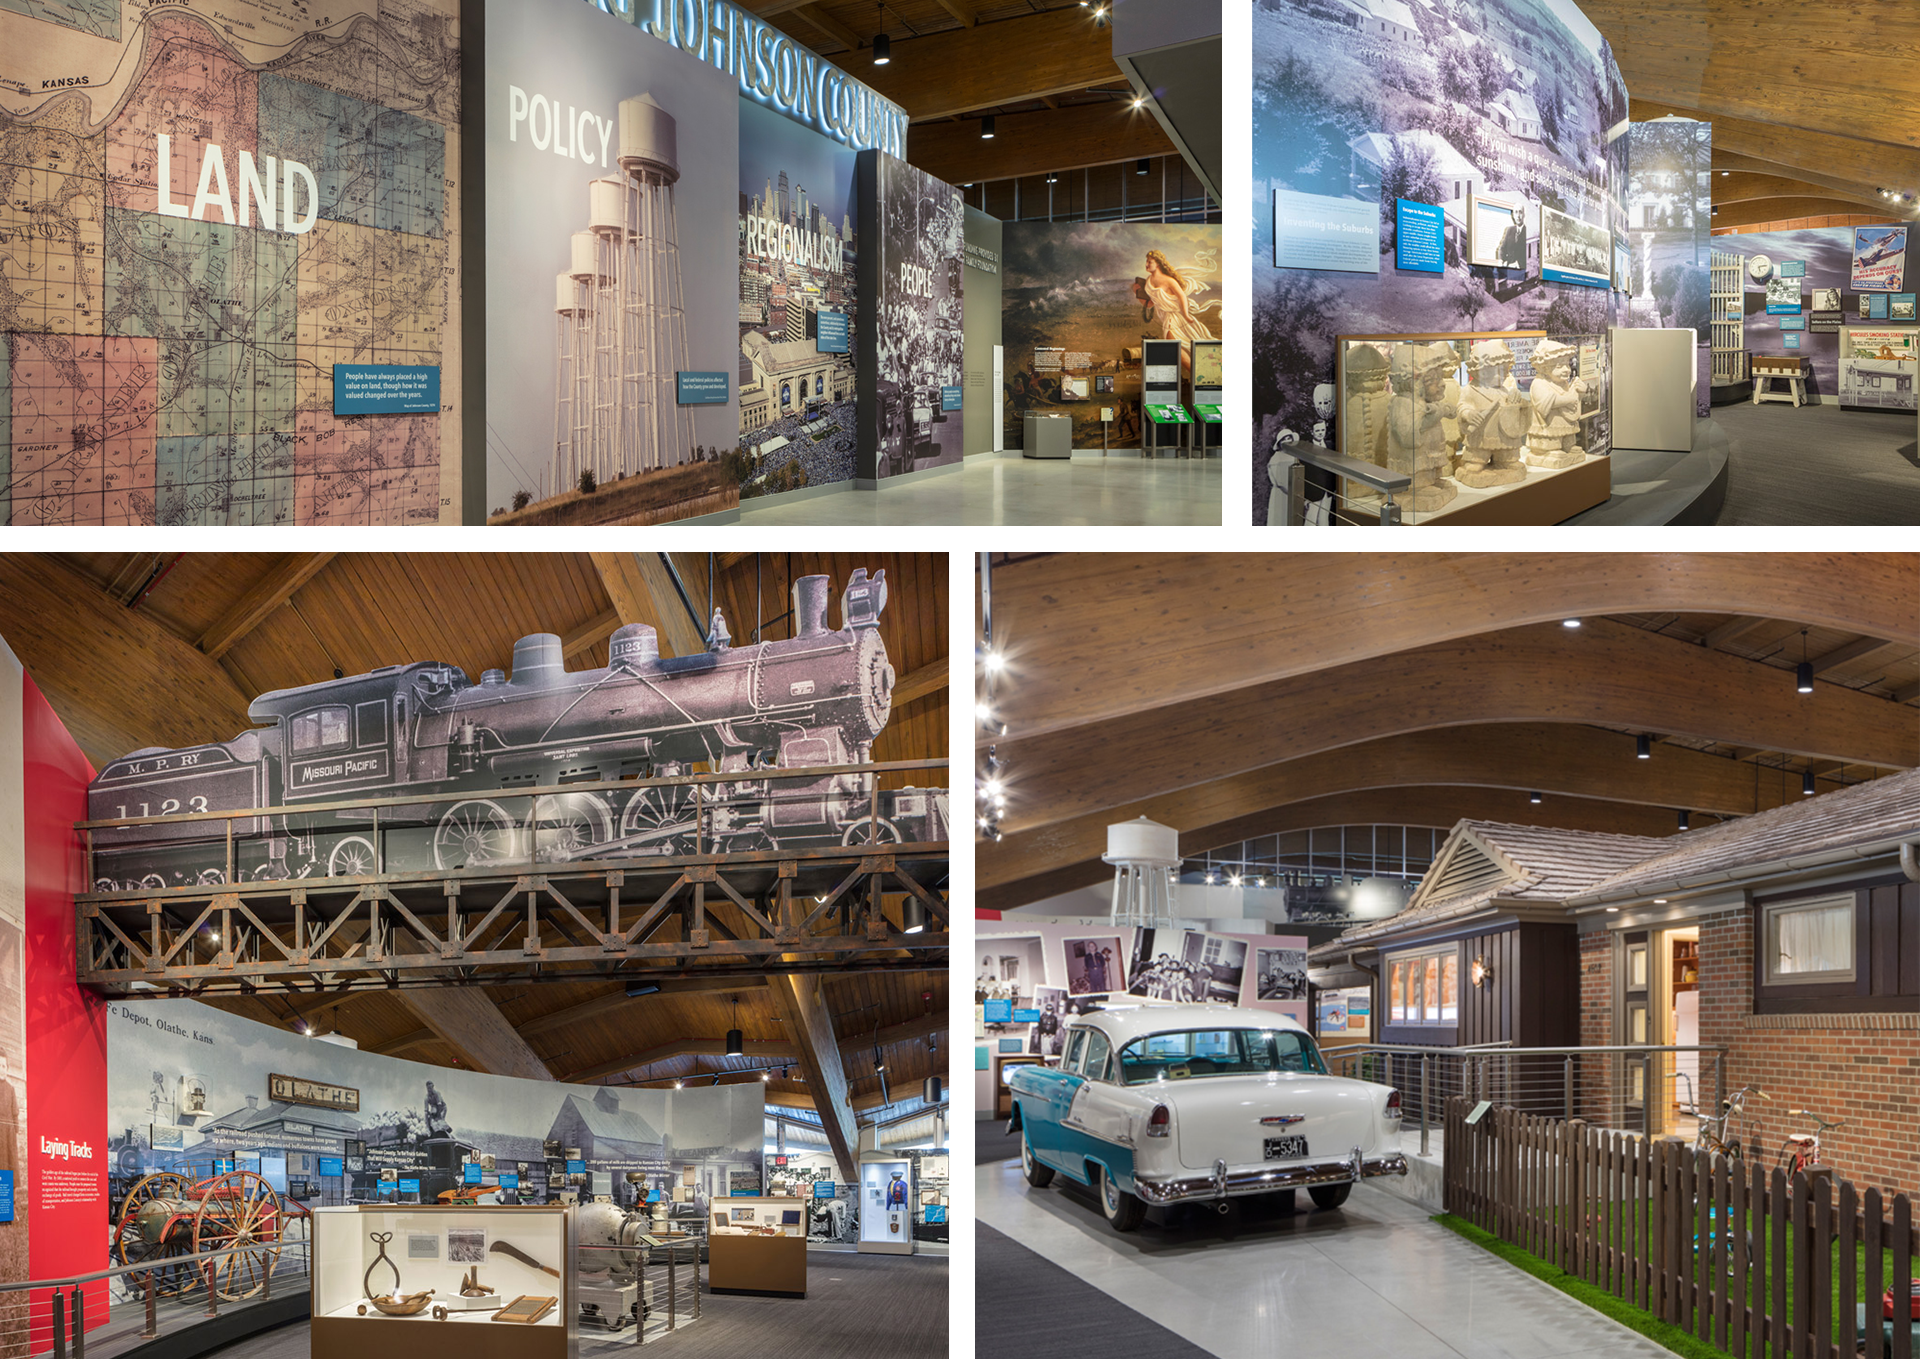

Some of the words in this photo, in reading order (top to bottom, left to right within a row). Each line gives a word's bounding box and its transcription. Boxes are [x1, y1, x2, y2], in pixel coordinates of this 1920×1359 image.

[42, 76, 89, 89] KANSAS
[646, 0, 818, 119] JOHNSON
[819, 66, 910, 163] COUNTY
[509, 84, 613, 168] POLICY
[1490, 139, 1507, 152] you
[1508, 143, 1527, 161] wish
[1527, 151, 1533, 163] a
[1476, 154, 1518, 178] sunshine,
[1520, 169, 1535, 183] and
[158, 133, 318, 235] LAND
[1283, 216, 1325, 232] Inventing
[1327, 222, 1341, 232] the
[1342, 223, 1374, 235] Suburbs
[747, 214, 844, 274] REGIONALISM
[1853, 272, 1876, 280] DEPENDS
[1869, 265, 1897, 273] ACCURACY
[901, 262, 933, 299] PEOPLE
[210, 298, 243, 307] OLATHE
[345, 372, 364, 382] People
[378, 373, 396, 382] always
[396, 373, 412, 382] placed
[417, 373, 428, 382] high
[345, 382, 360, 390] value
[369, 382, 383, 390] land,
[383, 382, 402, 391] though
[364, 392, 387, 401] changed
[408, 392, 423, 400] years.
[273, 432, 306, 444] BLACK
[316, 428, 337, 442] BOB
[17, 443, 59, 453] GARDNER
[613, 641, 641, 656] 1123
[128, 763, 145, 775] M.
[156, 758, 169, 770] P.
[275, 1078, 356, 1103] OLATHE
[247, 1131, 264, 1139] pushed
[286, 1123, 313, 1133] OLATHE
[41, 1135, 69, 1161] Laying
[69, 1140, 93, 1159] Tracks
